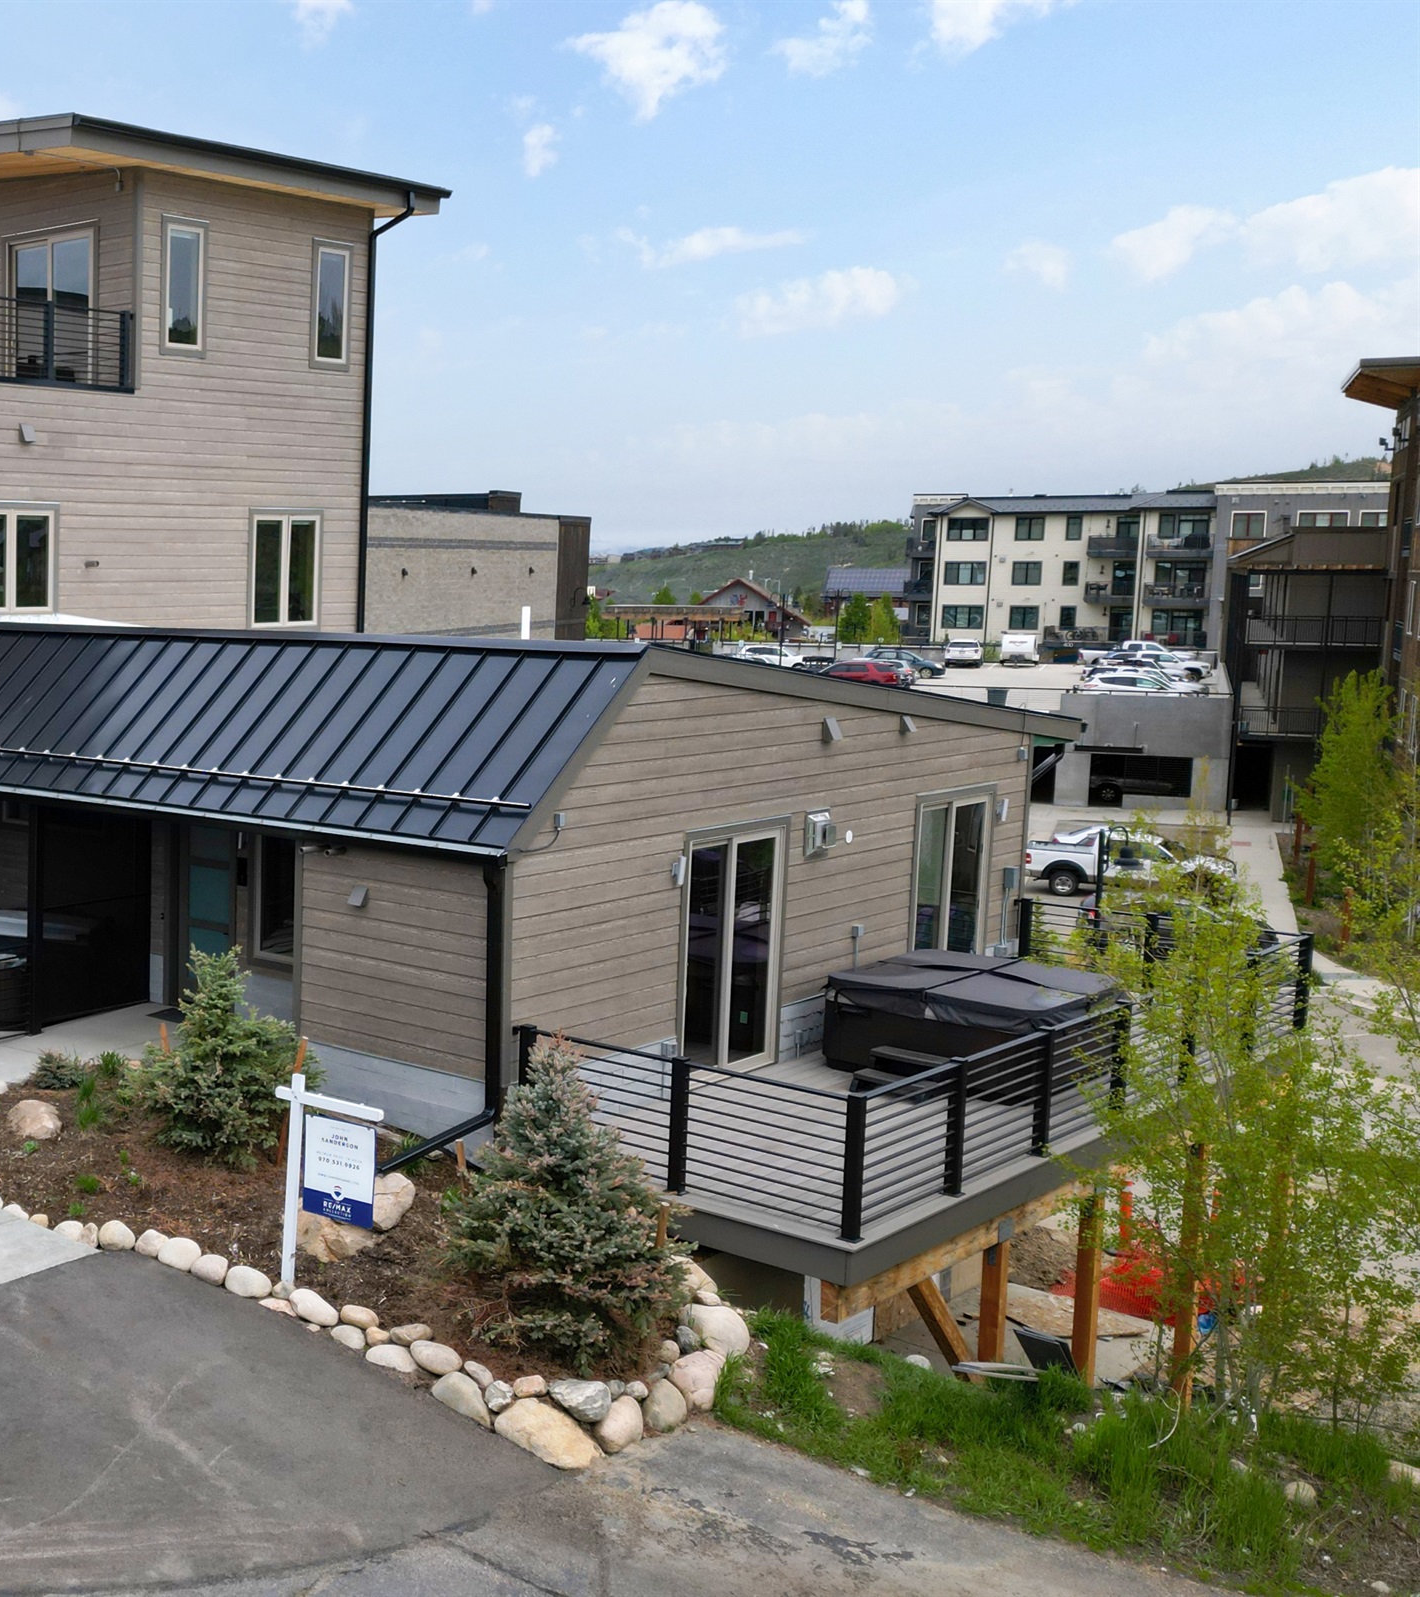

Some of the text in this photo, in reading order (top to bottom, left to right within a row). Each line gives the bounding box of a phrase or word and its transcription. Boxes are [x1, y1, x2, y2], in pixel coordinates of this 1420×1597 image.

[321, 1137, 359, 1150] SANDERSON
[331, 1134, 348, 1142] JOHN
[323, 1200, 351, 1213] RE/MAX
